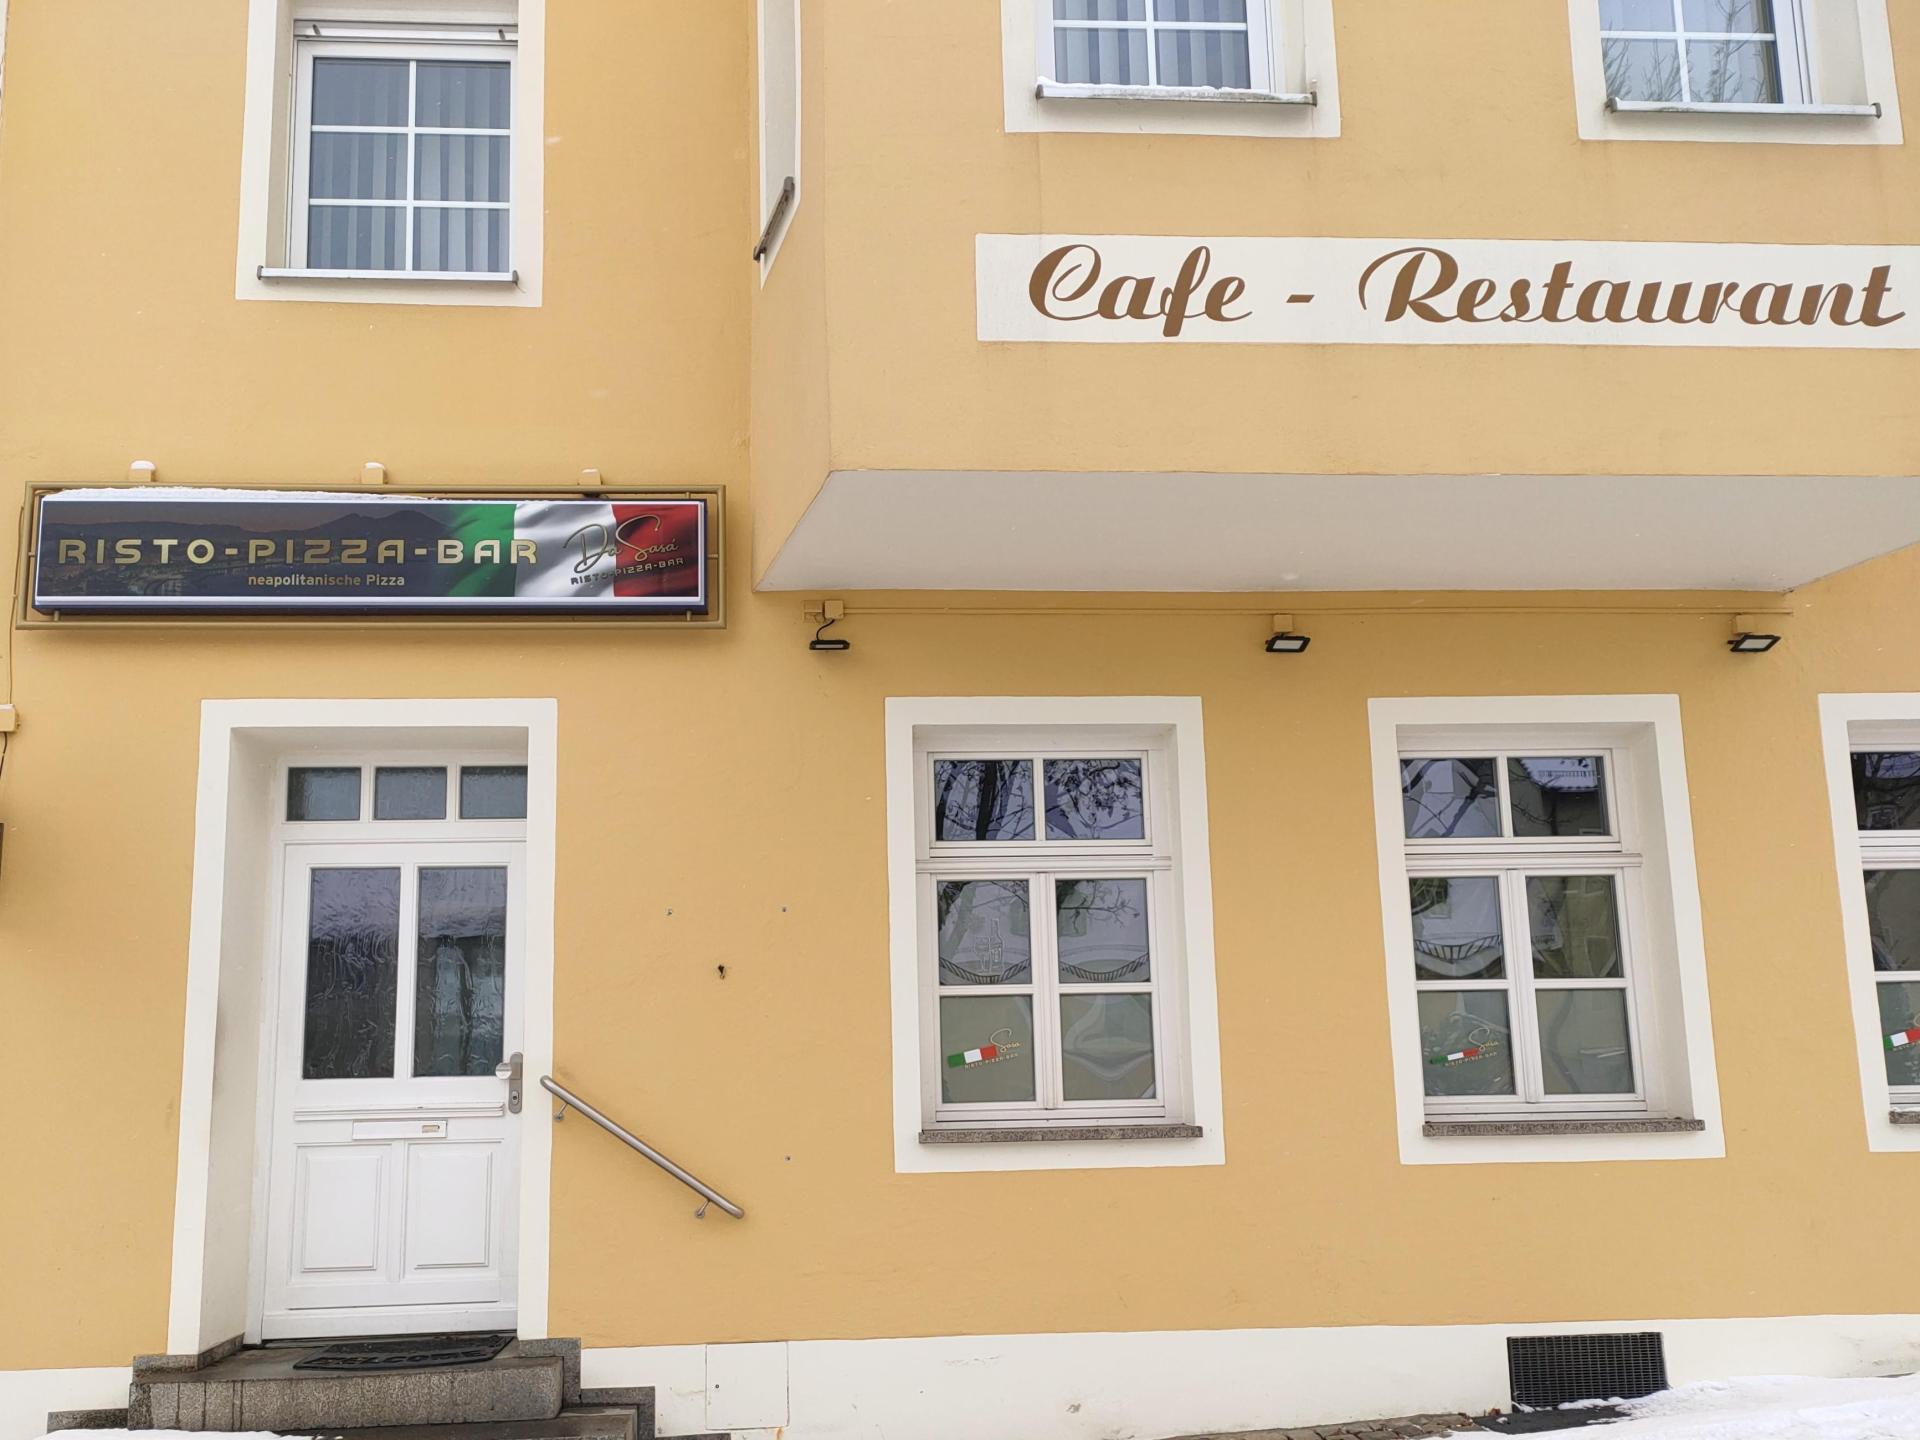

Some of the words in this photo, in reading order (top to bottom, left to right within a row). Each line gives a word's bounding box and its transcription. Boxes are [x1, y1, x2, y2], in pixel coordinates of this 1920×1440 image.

[1028, 243, 1253, 338] Cafe
[1286, 294, 1315, 304] -
[1357, 246, 1907, 328] Restaurant
[57, 538, 538, 565] RISTO-PIZZA-BAR
[562, 523, 622, 574] Da
[248, 574, 361, 588] neapolitanische
[366, 574, 406, 587] Pizza
[570, 557, 685, 586] RISTO-PIZZA-BAR
